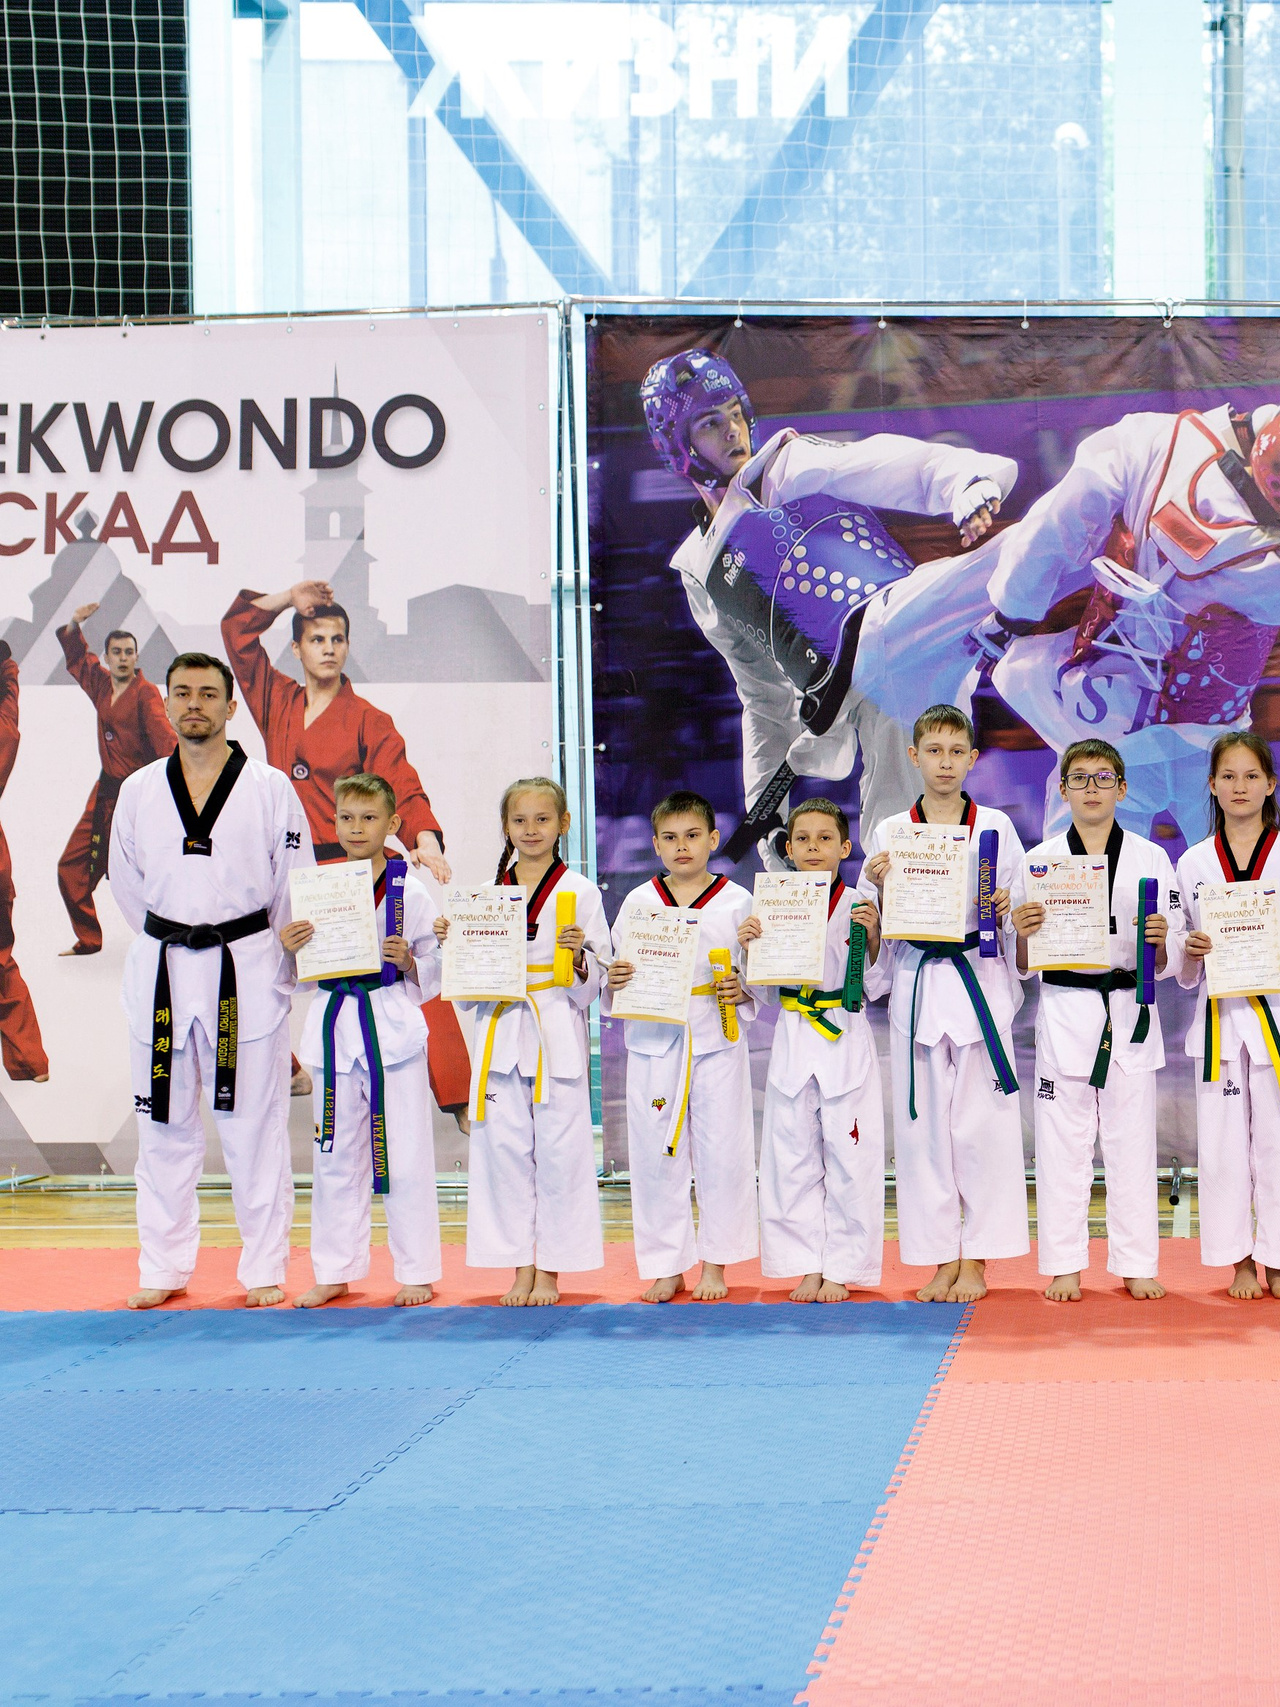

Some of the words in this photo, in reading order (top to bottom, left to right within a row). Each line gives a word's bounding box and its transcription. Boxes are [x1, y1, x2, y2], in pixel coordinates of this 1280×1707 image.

[0, 394, 446, 474] KWONDO
[0, 490, 219, 566] СКАД
[894, 850, 941, 861] TAEKWONDO
[946, 853, 957, 861] WT
[903, 867, 950, 876] СЕРТИФИКАТ
[980, 857, 991, 920] TAEKWONDO
[1036, 883, 1082, 891] TAEKWONDO
[1087, 882, 1098, 890] WT
[760, 899, 804, 907] TAEKWONDO
[808, 899, 818, 907] WT
[310, 905, 356, 915] СЕРТИФИКАТ
[1209, 910, 1255, 920] TAEKWONDO
[1259, 908, 1270, 916] WT
[453, 914, 499, 922] TAEKWONDO
[504, 914, 515, 922] WT
[1220, 924, 1265, 934] СЕРТИФИКАТ
[631, 931, 674, 943] TAEKWONDO
[678, 936, 689, 945] WT
[637, 948, 680, 958] СЕРТИФИКАТ
[850, 924, 864, 985] TAEKWONDO
[219, 1000, 229, 1032] BATYROV
[217, 1037, 228, 1067] BOGDAN
